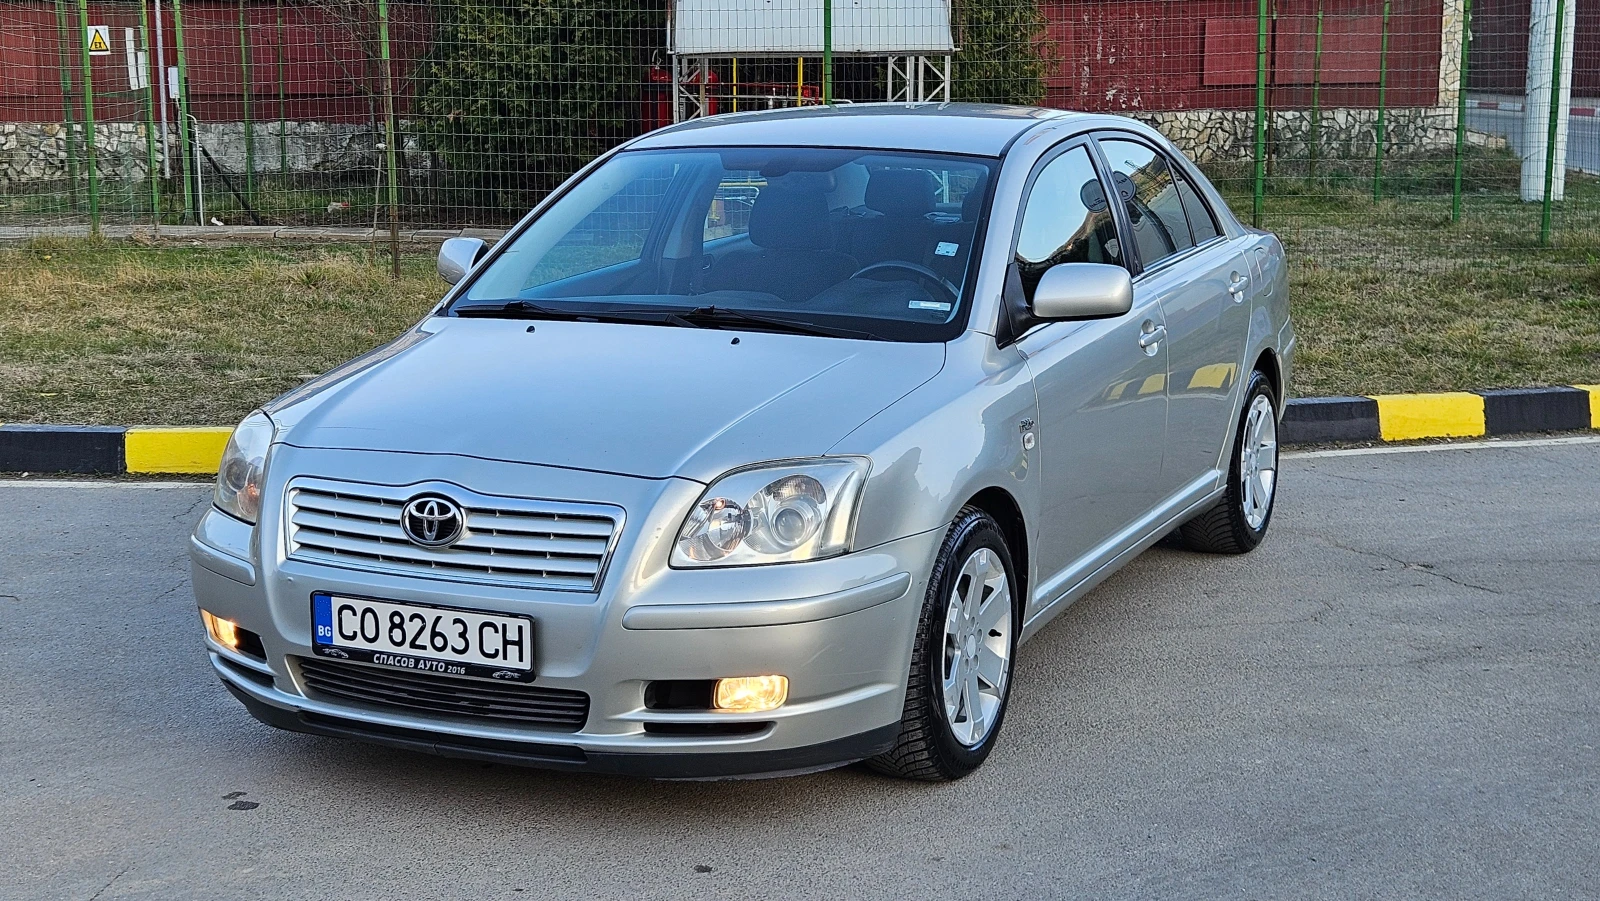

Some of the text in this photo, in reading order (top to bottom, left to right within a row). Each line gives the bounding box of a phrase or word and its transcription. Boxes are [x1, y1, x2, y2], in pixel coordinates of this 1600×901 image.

[318, 625, 332, 637] BG
[337, 604, 524, 662] CO 8263 CH
[373, 653, 466, 674] СПАСОВ АУТО 2016
